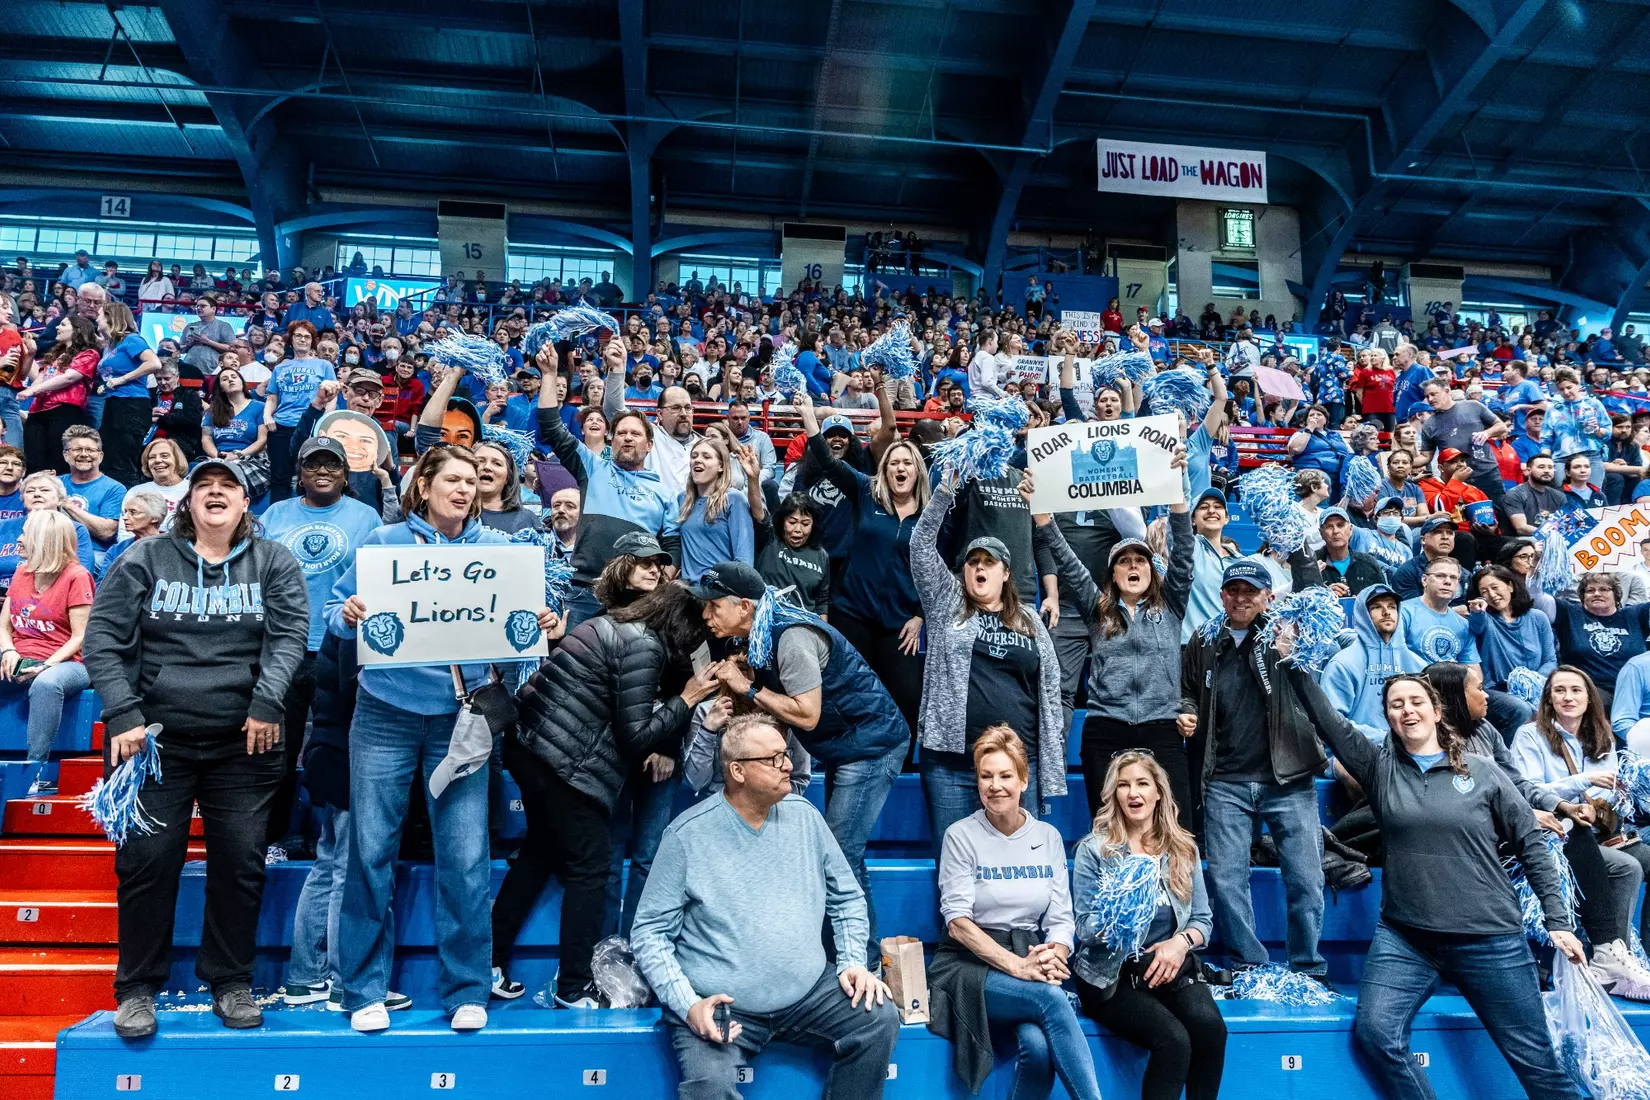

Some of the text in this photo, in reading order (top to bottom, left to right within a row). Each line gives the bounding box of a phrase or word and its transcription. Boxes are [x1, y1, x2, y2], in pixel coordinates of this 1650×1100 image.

[1102, 151, 1263, 189] JUST LOAD THE WAGON
[105, 197, 127, 216] 14
[1224, 212, 1253, 220] LONGINES
[461, 242, 482, 260] 15
[804, 263, 823, 280] 16
[1125, 283, 1142, 298] 17
[1064, 311, 1080, 319] THIS
[1082, 312, 1091, 320] IS
[1072, 320, 1088, 328] KIND
[1076, 329, 1100, 343] NESS
[1031, 432, 1073, 462] ROAR
[1087, 423, 1131, 439] LIONS
[1138, 425, 1178, 453] ROAR
[1079, 472, 1134, 483] BASKETBALL
[1087, 466, 1125, 475] WOMEN'S
[979, 485, 1020, 495] COLUMB
[1068, 479, 1144, 499] COLUMBIA
[983, 500, 1029, 510] BASKETBALL
[991, 495, 1022, 503] WOMEN'S
[1574, 508, 1650, 571] BOOM
[392, 560, 497, 585] Let's Go
[151, 578, 264, 615] COLUMBIA
[410, 593, 498, 623] Lions!
[149, 611, 264, 622] LIONS
[1369, 663, 1401, 673] LUMB
[515, 800, 521, 811] 3
[24, 908, 32, 921] 2
[1288, 1056, 1295, 1069] 9
[439, 1073, 447, 1088] 3
[590, 1070, 599, 1084] 4
[738, 1068, 746, 1082] 5
[126, 1076, 132, 1090] 1
[283, 1076, 291, 1090] 2
